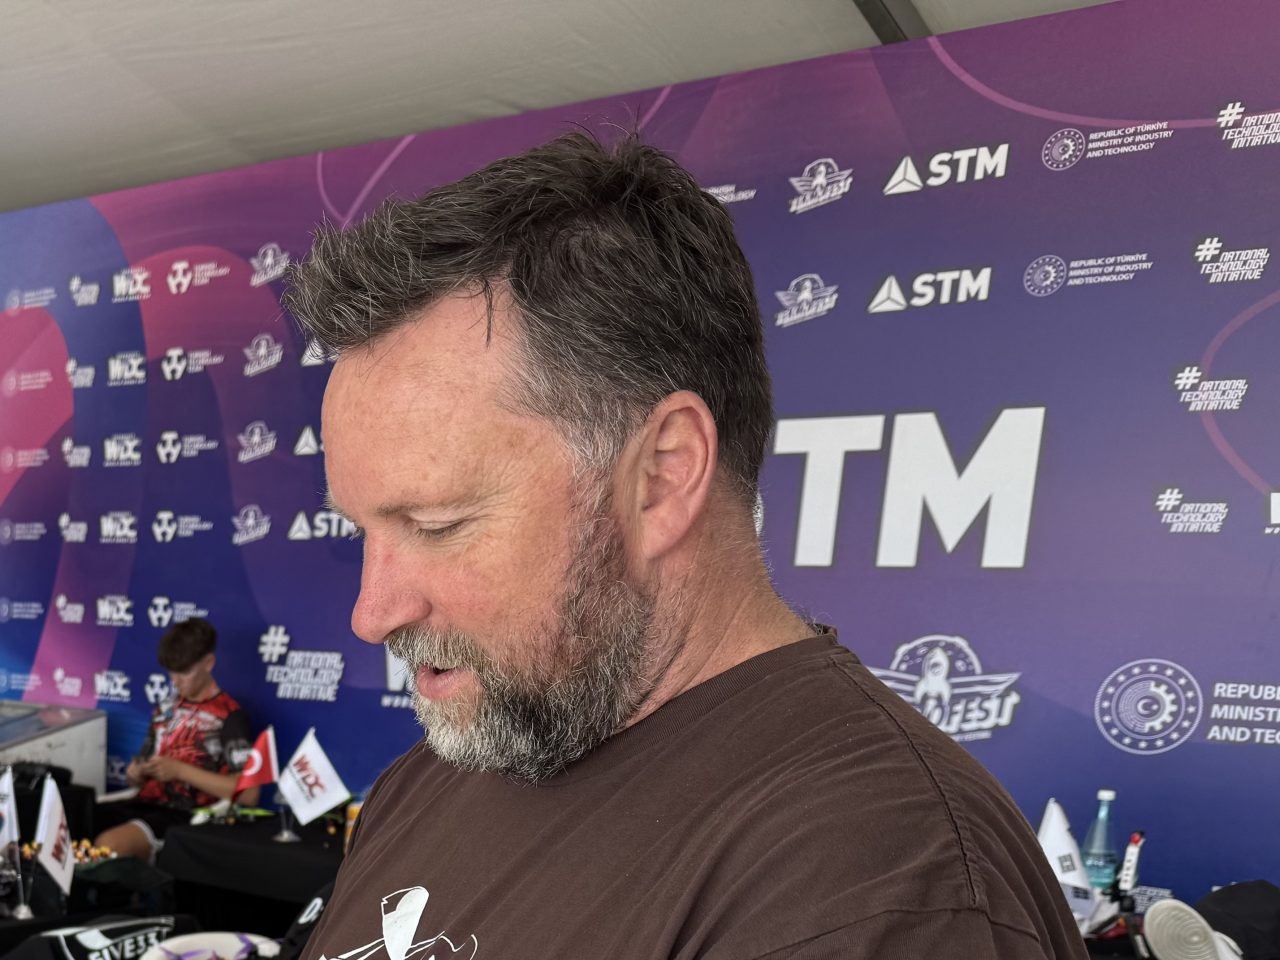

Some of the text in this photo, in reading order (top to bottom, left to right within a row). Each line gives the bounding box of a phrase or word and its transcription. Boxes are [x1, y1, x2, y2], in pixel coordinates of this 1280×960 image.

[1088, 130, 1174, 149] MINISTRY OF INDUSTRY
[1089, 129, 1125, 140] REPUBLIC
[1125, 127, 1136, 135] OF
[1086, 142, 1155, 158] AND TECHNOLOGY
[926, 143, 1009, 187] STM
[1219, 248, 1270, 263] NATIONAL
[1200, 259, 1267, 274] TECHNOLOGY
[1209, 269, 1264, 283] INITIATIVE
[910, 266, 992, 307] STM
[1198, 379, 1248, 392] NATIONAL
[1180, 389, 1245, 402] TECHNOLOGY
[1188, 399, 1242, 411] INITIATIVE
[770, 407, 1046, 567] TM
[1207, 725, 1251, 742] AND
